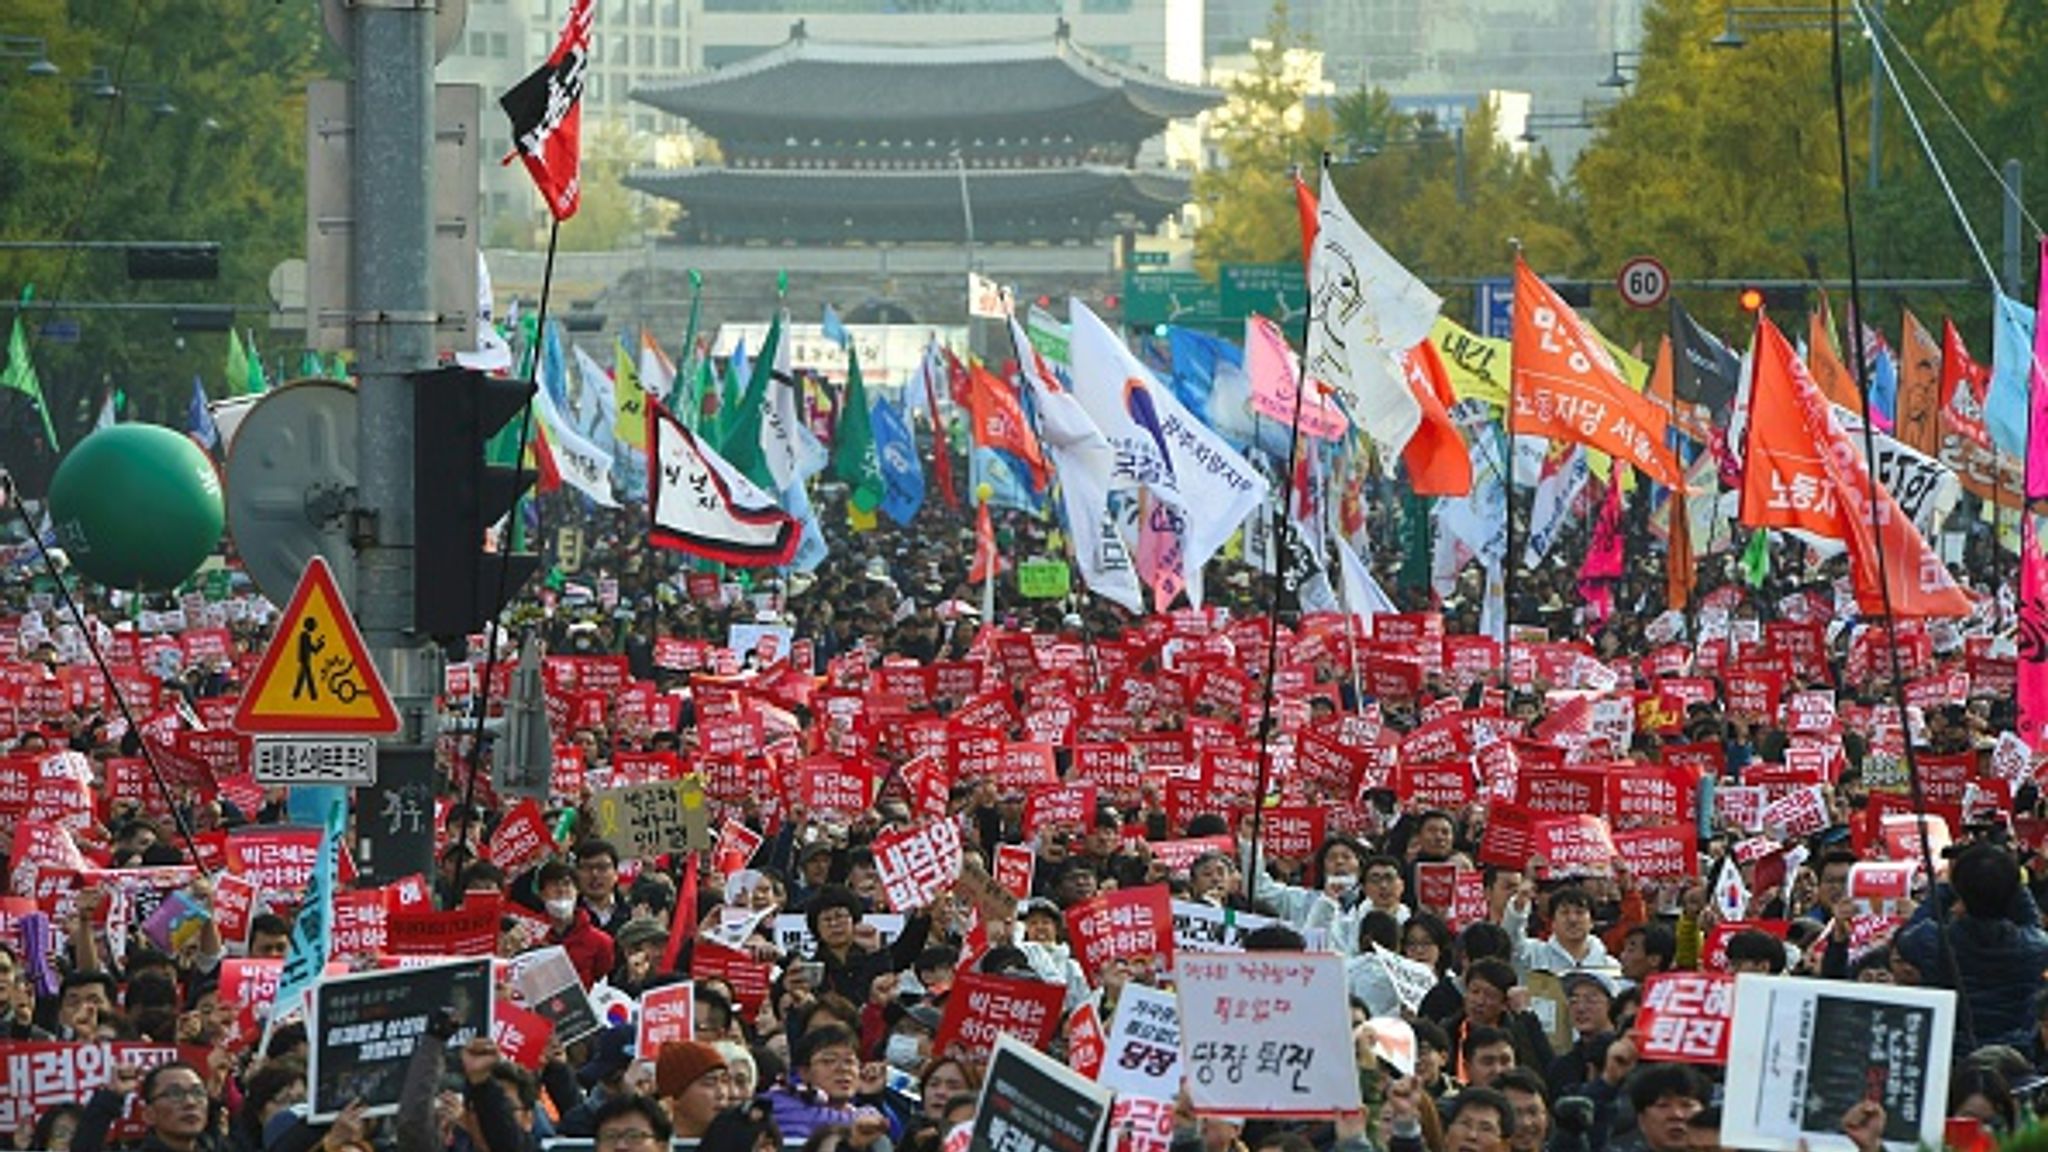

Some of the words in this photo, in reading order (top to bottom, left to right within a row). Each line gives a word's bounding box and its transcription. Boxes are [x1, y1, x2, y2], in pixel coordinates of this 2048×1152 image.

[1630, 271, 1660, 294] 60
[1644, 1016, 1724, 1056] 퇴진
[1191, 1040, 1248, 1084] 당장
[1256, 1041, 1315, 1094] 퇴진
